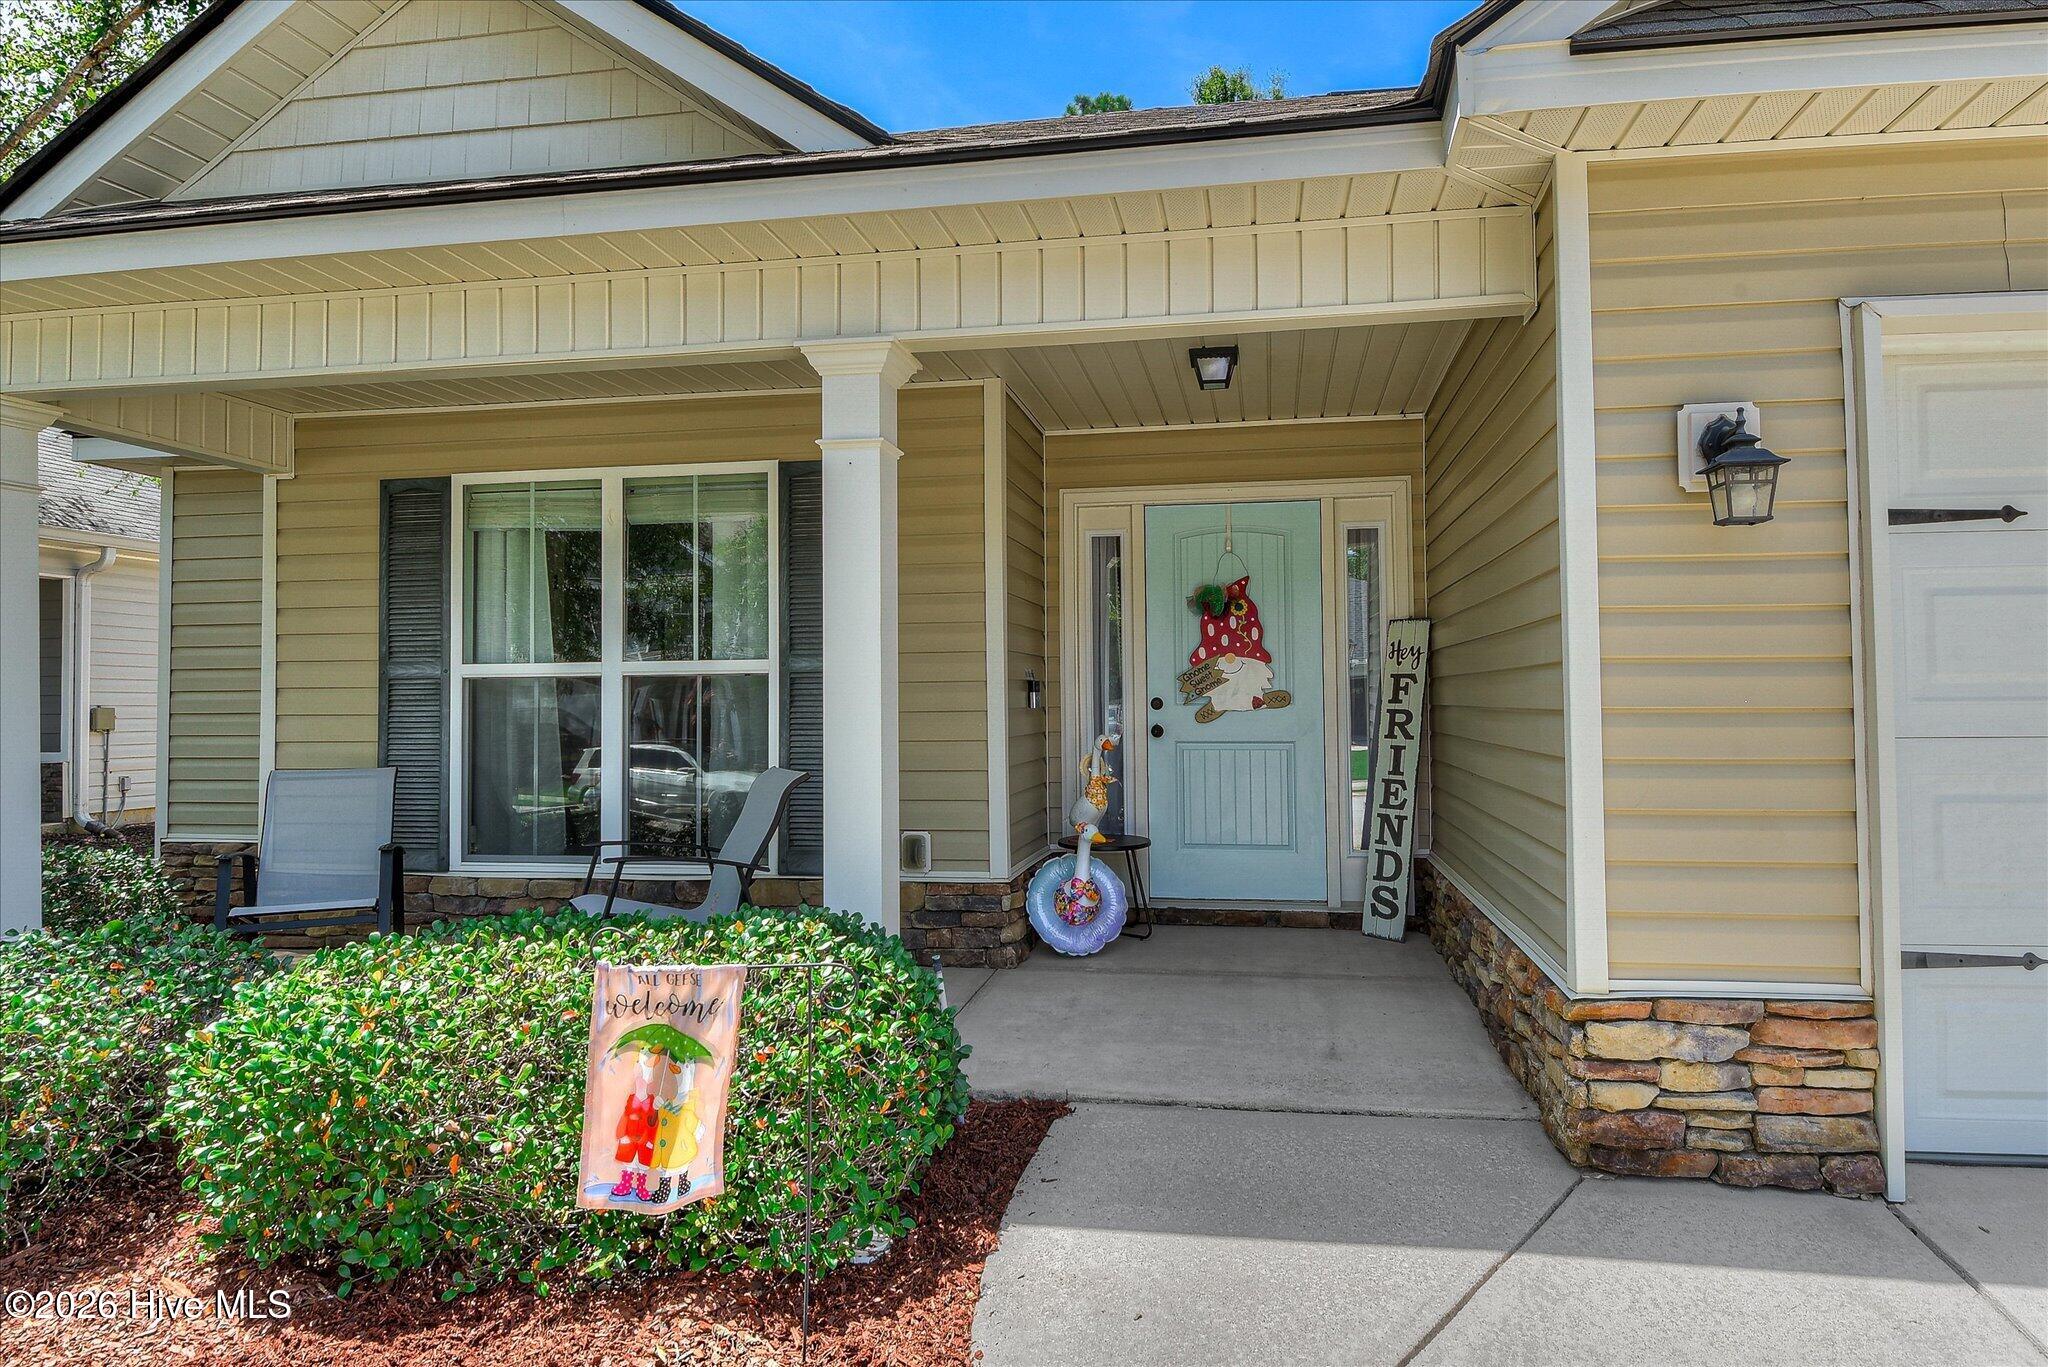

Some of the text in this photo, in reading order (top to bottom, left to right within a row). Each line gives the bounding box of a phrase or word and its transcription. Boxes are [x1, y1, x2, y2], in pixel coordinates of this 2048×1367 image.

[1388, 639, 1425, 670] Hey
[1181, 662, 1212, 683] Gnome
[1189, 670, 1213, 688] Sweet
[1194, 677, 1223, 696] Gnome
[1370, 673, 1418, 920] FRIENDS
[638, 973, 702, 986] ALL GEESE
[606, 991, 723, 1023] welcome
